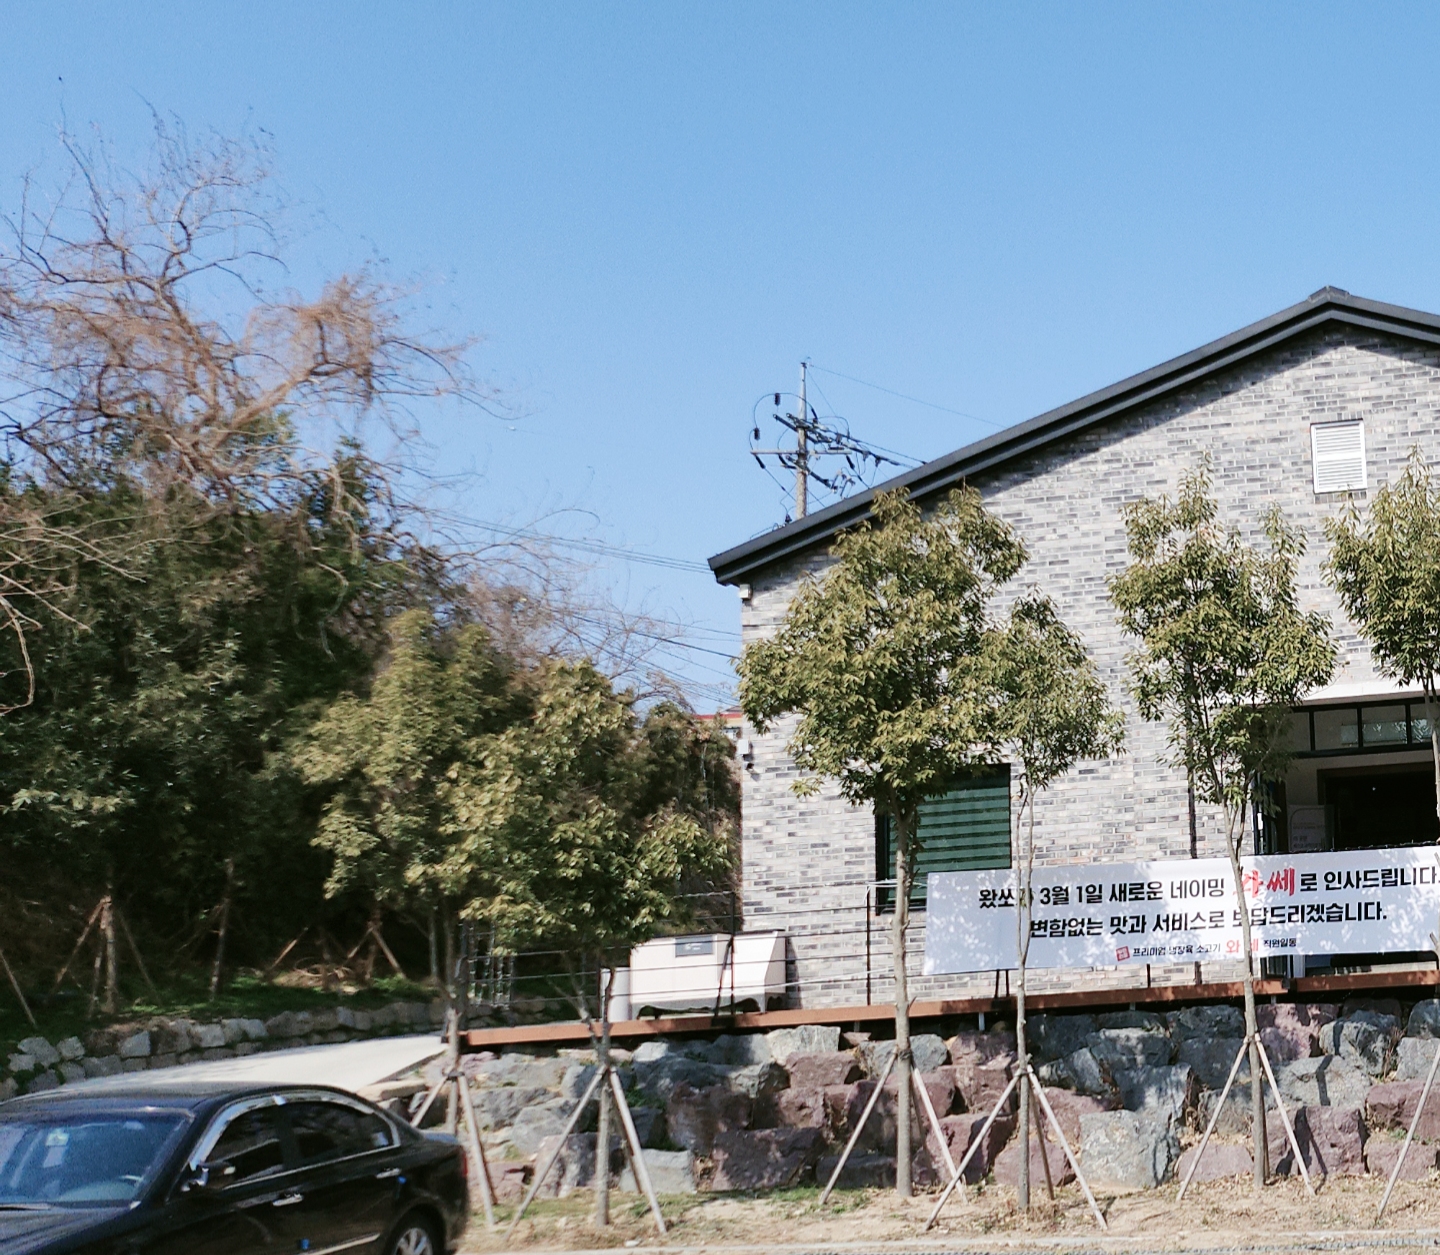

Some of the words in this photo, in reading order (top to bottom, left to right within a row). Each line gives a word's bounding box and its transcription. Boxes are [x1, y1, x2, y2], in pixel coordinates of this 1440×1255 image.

[1040, 886, 1070, 906] 3월
[1076, 884, 1103, 904] 1일
[1109, 881, 1163, 902] 새로운
[1170, 878, 1225, 899] 네이밍
[1030, 918, 1103, 938] 변함없는
[1110, 914, 1147, 935] 맛과
[1152, 910, 1225, 932] 서비스로
[1232, 901, 1387, 928] 보답드리겠습니다.
[1133, 946, 1166, 957] 프리미엄
[1196, 943, 1221, 953] 소고기
[1263, 937, 1297, 949] 직원일동
